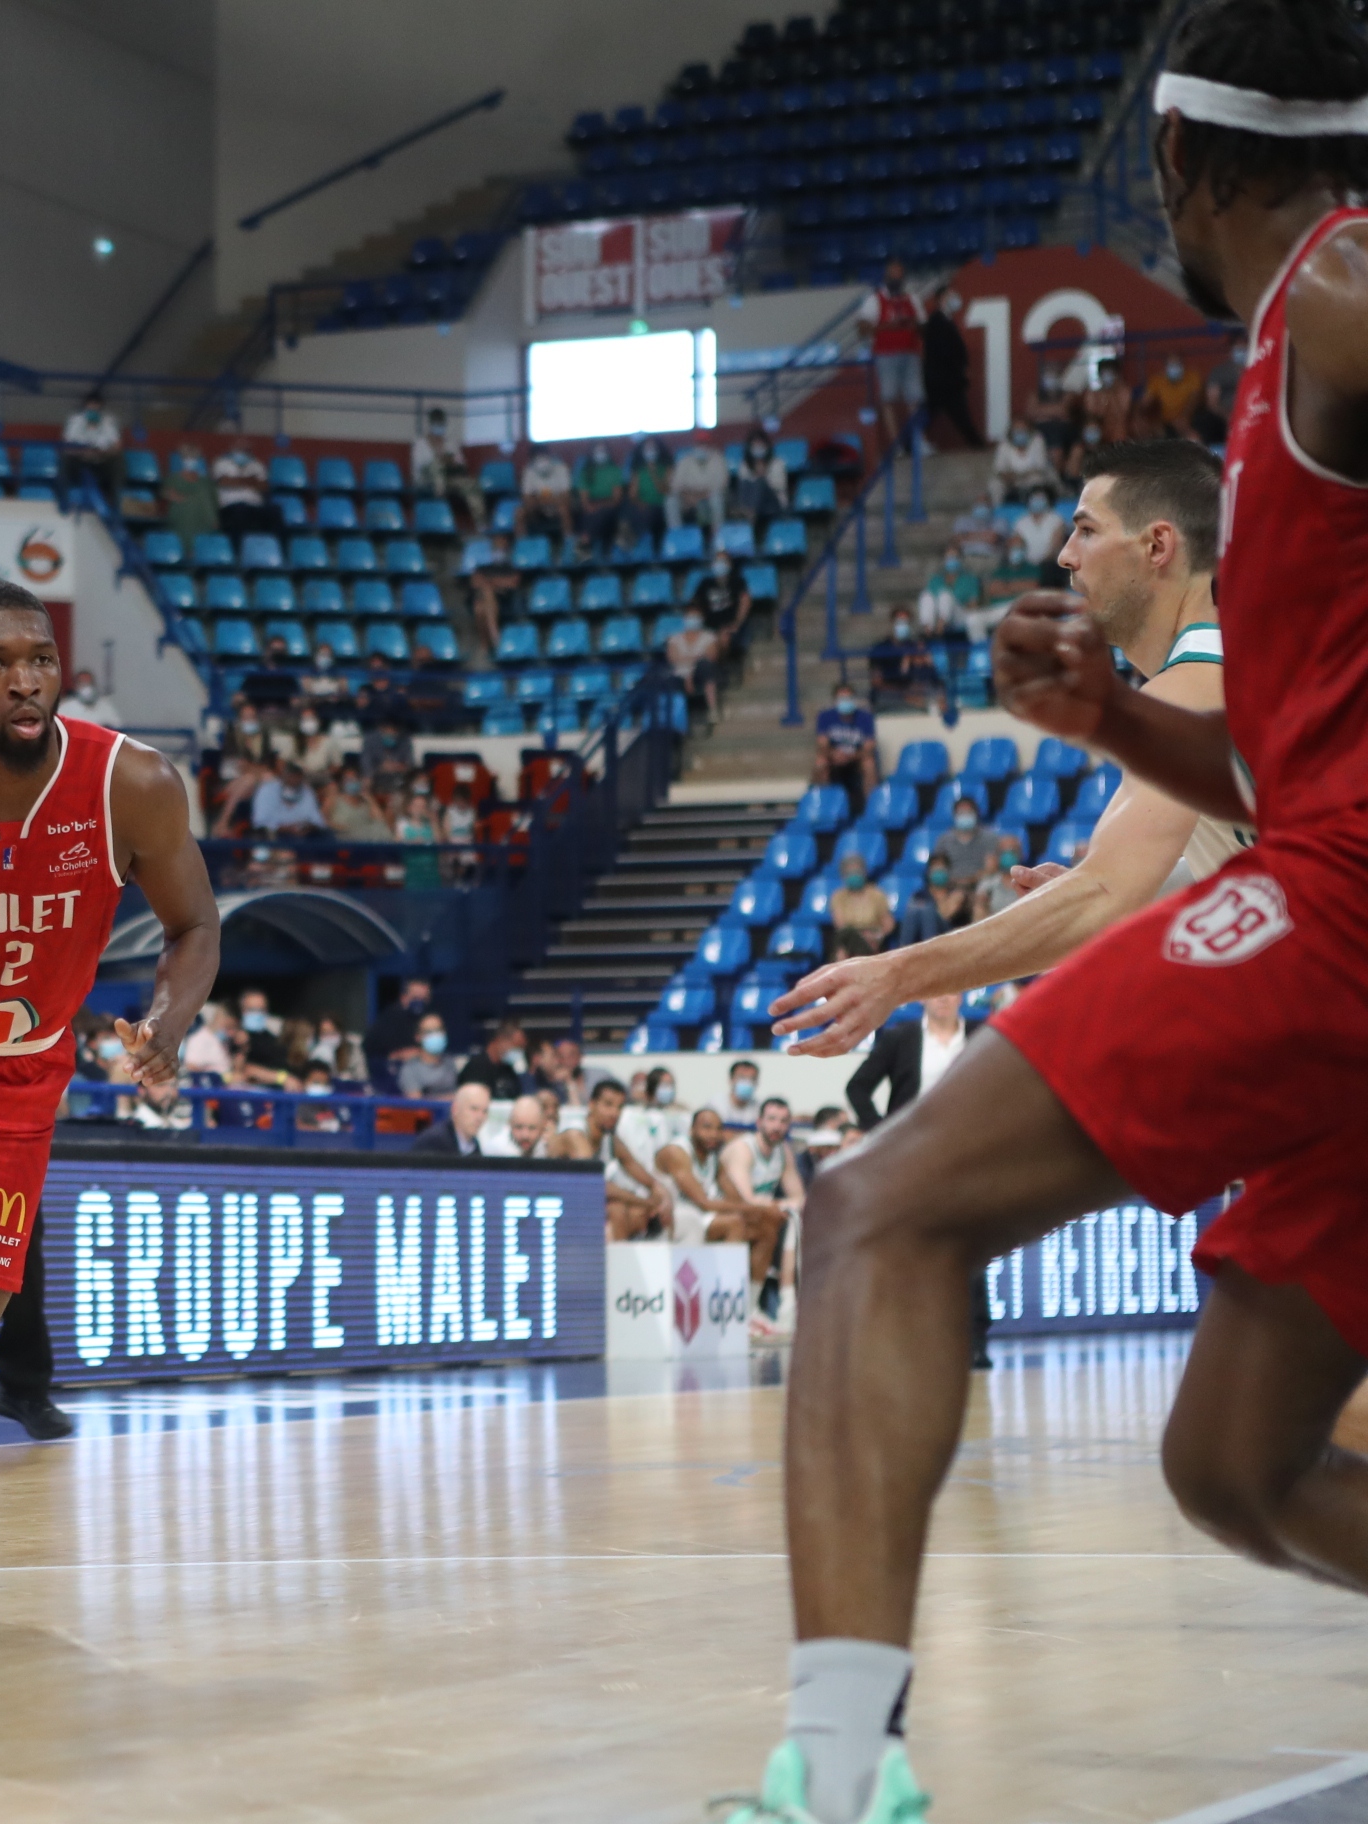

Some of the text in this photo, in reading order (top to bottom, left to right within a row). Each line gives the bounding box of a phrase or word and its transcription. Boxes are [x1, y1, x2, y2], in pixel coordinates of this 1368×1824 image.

[649, 256, 736, 300] OUES
[49, 864, 60, 873] Le
[75, 1190, 345, 1367] GROUPE
[376, 1194, 563, 1346] MALET
[615, 1287, 665, 1320] dpd
[709, 1272, 746, 1336] dpd
